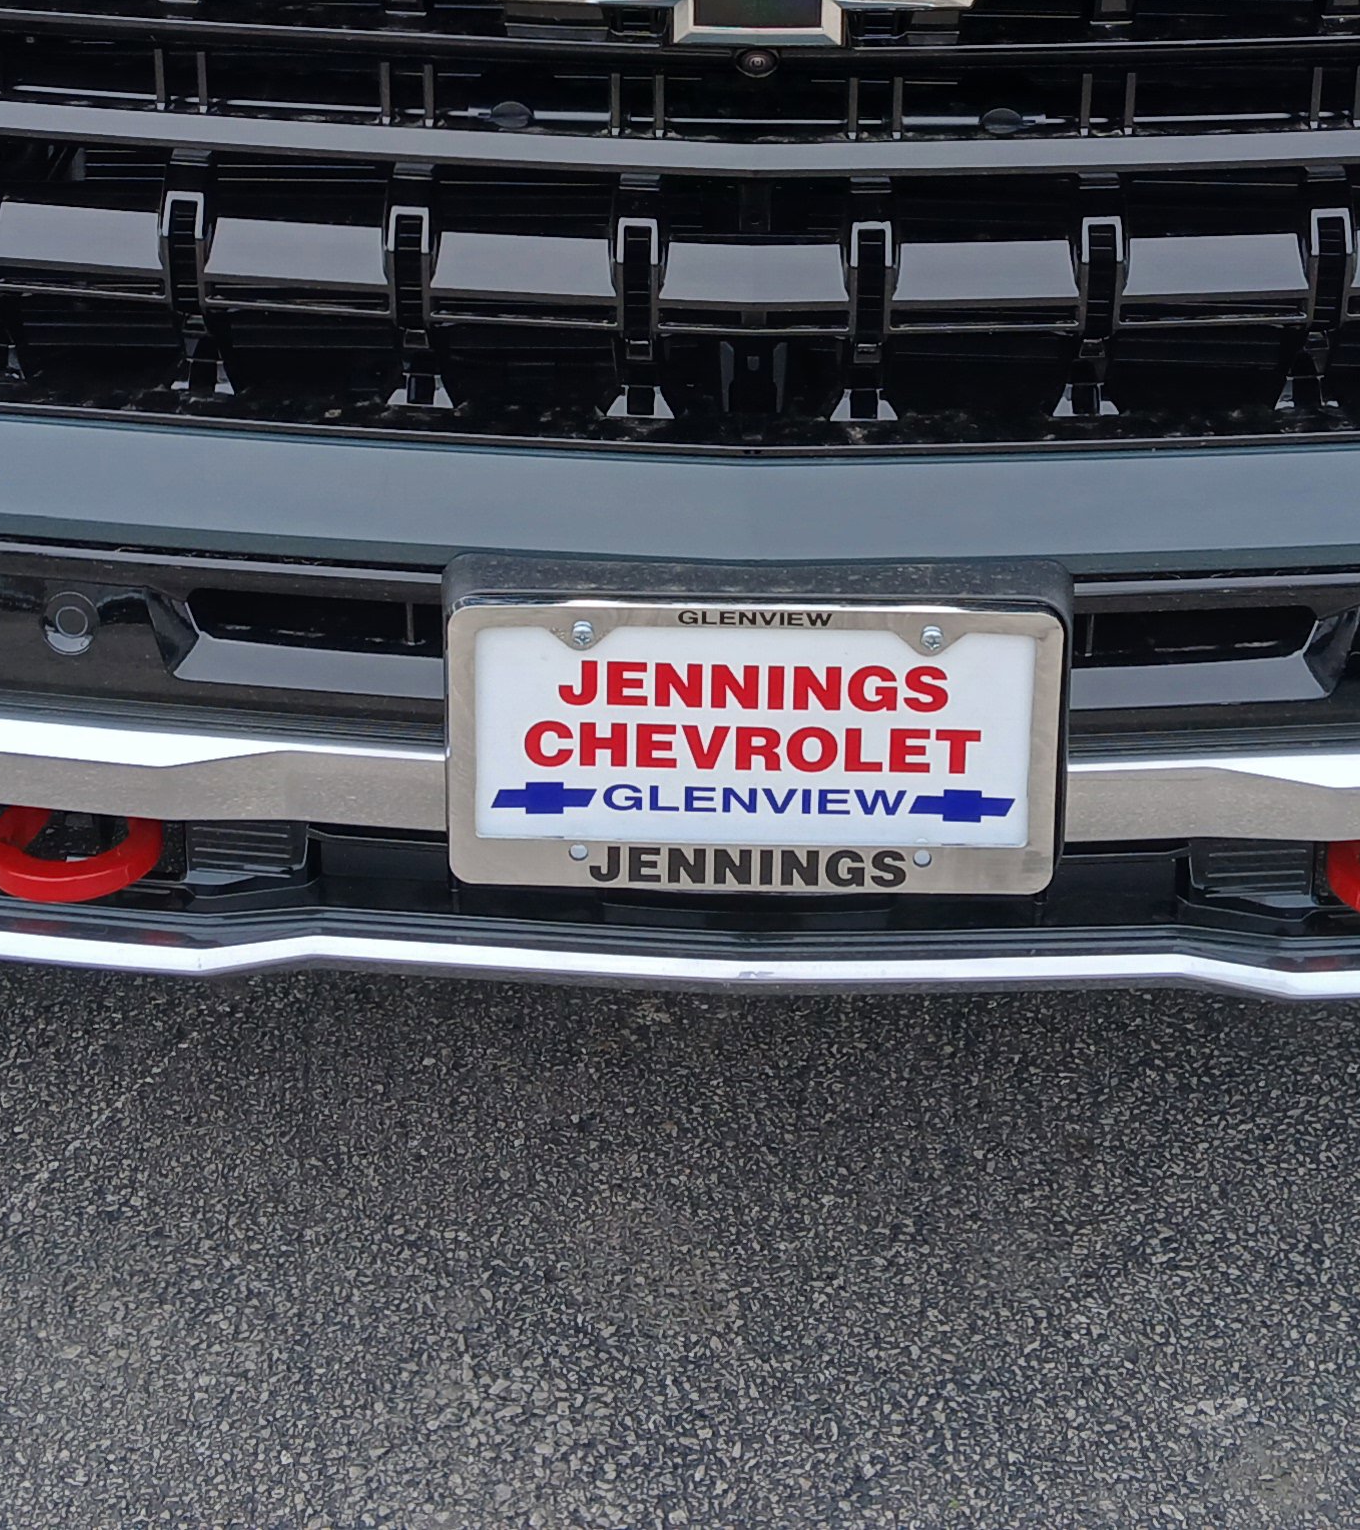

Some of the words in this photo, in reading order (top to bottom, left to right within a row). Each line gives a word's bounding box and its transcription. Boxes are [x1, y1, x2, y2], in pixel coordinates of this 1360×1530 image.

[677, 609, 833, 627] GLENVIEW
[558, 660, 949, 713] JENNINGS
[524, 721, 982, 774] CHEVROLET
[602, 784, 907, 816] GLENVIEW
[588, 846, 907, 888] JENNINGS
